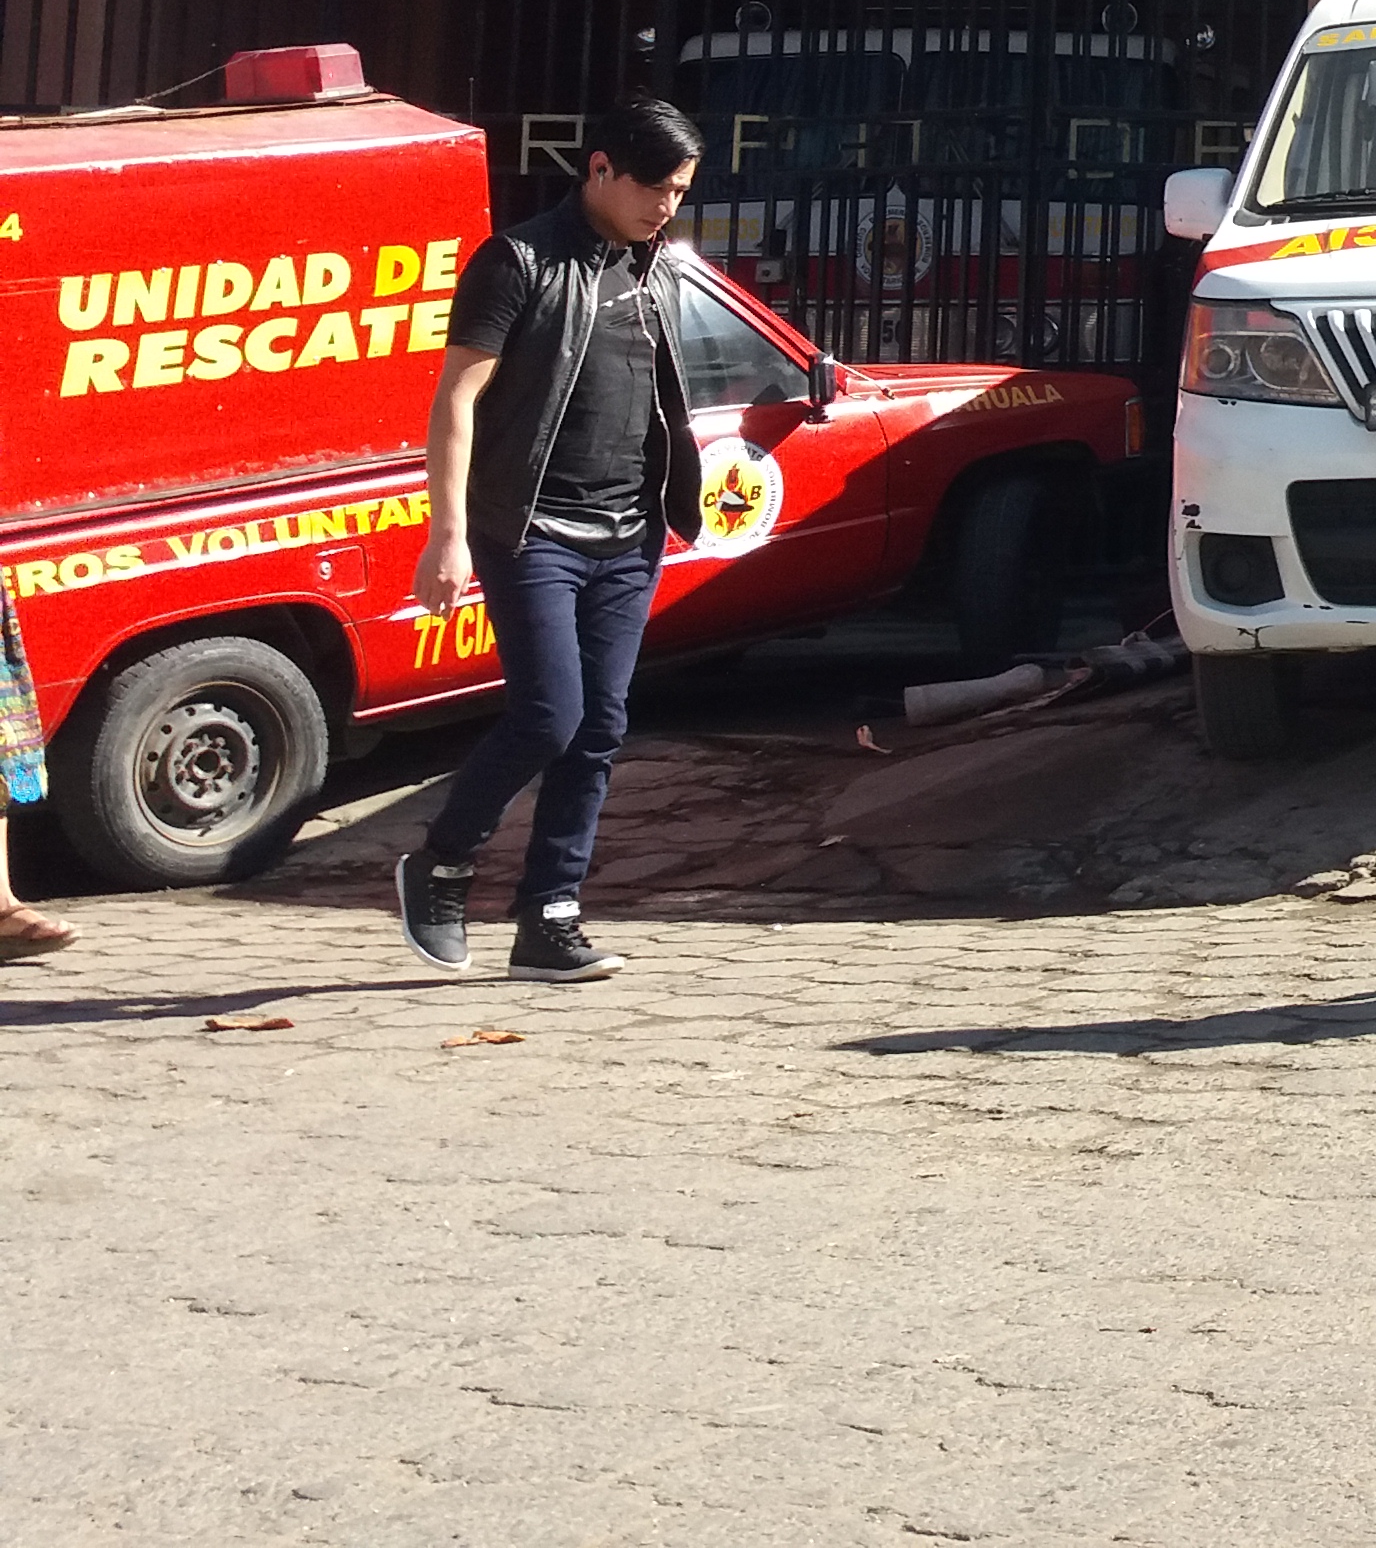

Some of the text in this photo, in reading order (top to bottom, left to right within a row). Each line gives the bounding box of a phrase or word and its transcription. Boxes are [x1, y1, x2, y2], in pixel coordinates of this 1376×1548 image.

[58, 239, 460, 331] UNIDAD DE
[60, 298, 452, 397] RESCATE
[413, 614, 448, 669] 77
